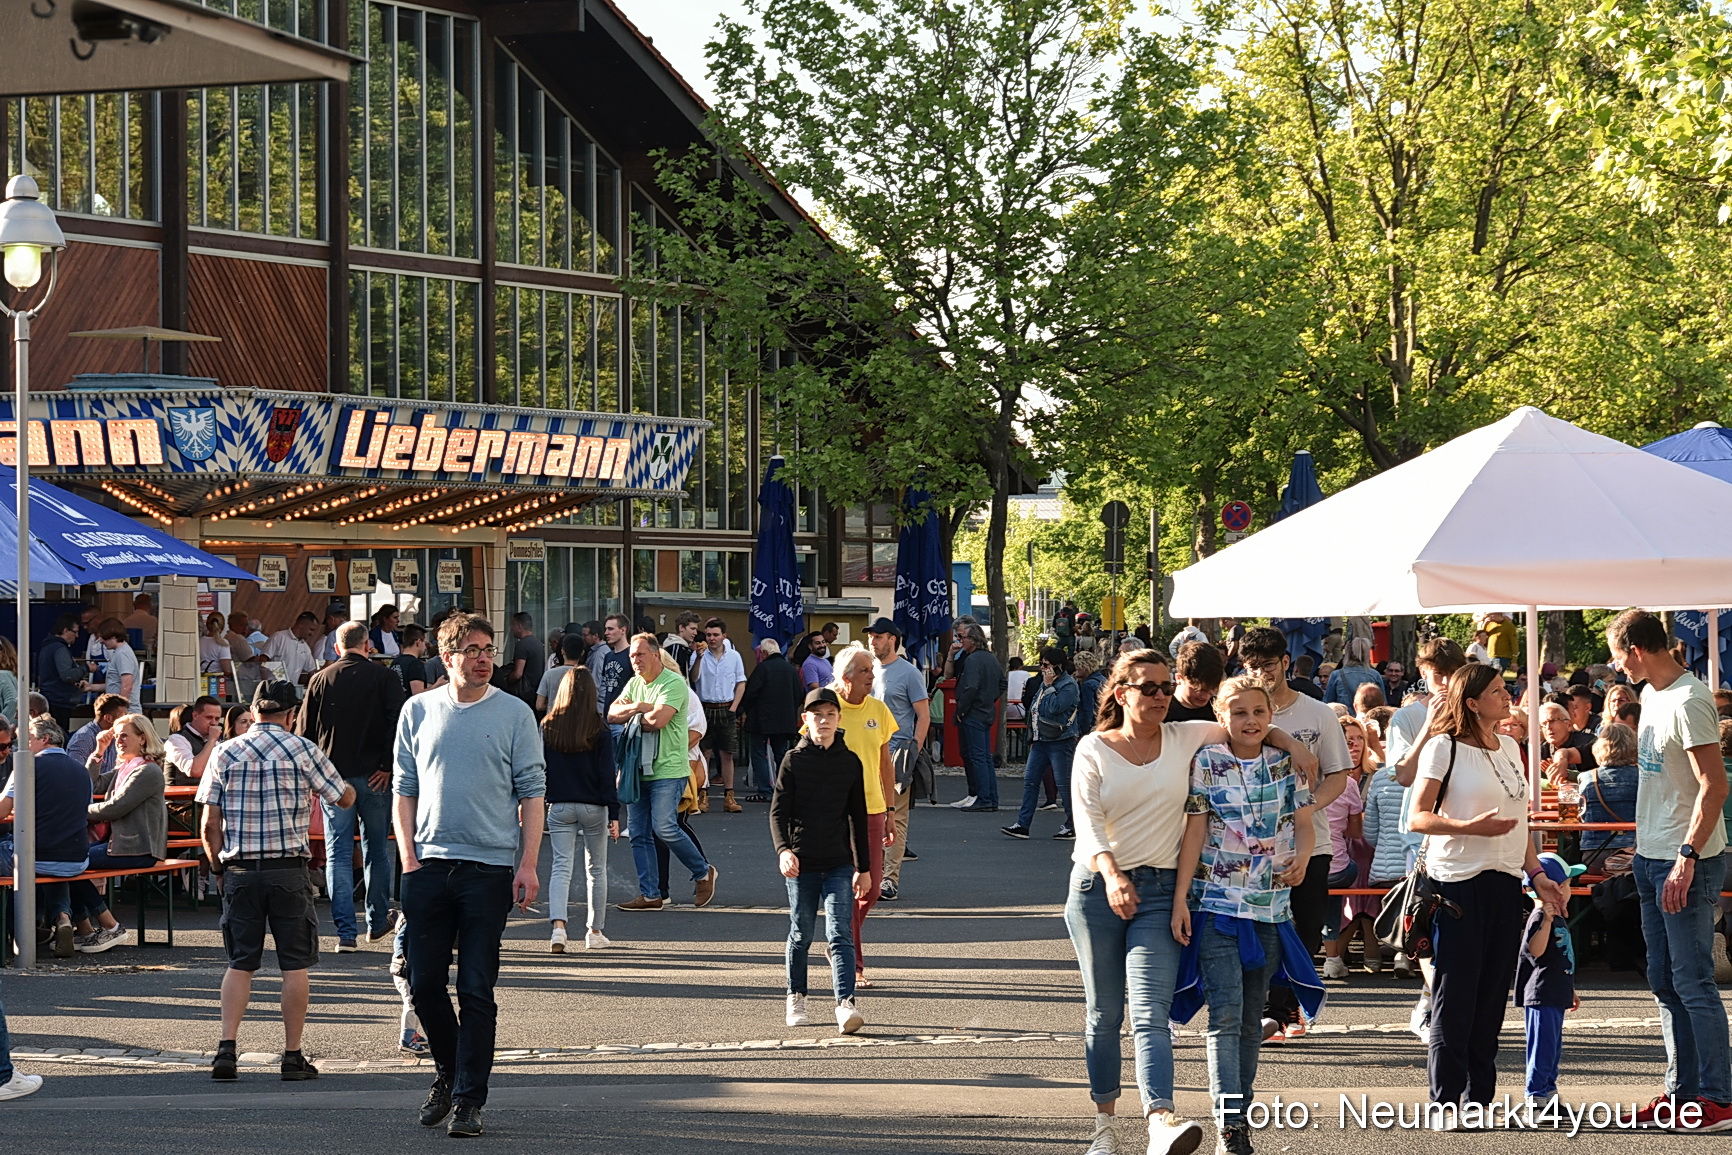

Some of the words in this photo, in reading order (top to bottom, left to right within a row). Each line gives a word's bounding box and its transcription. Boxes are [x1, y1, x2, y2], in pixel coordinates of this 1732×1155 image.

[339, 409, 631, 480] Liebermann
[311, 559, 333, 574] Currywurst
[352, 562, 373, 574] Bockwurst
